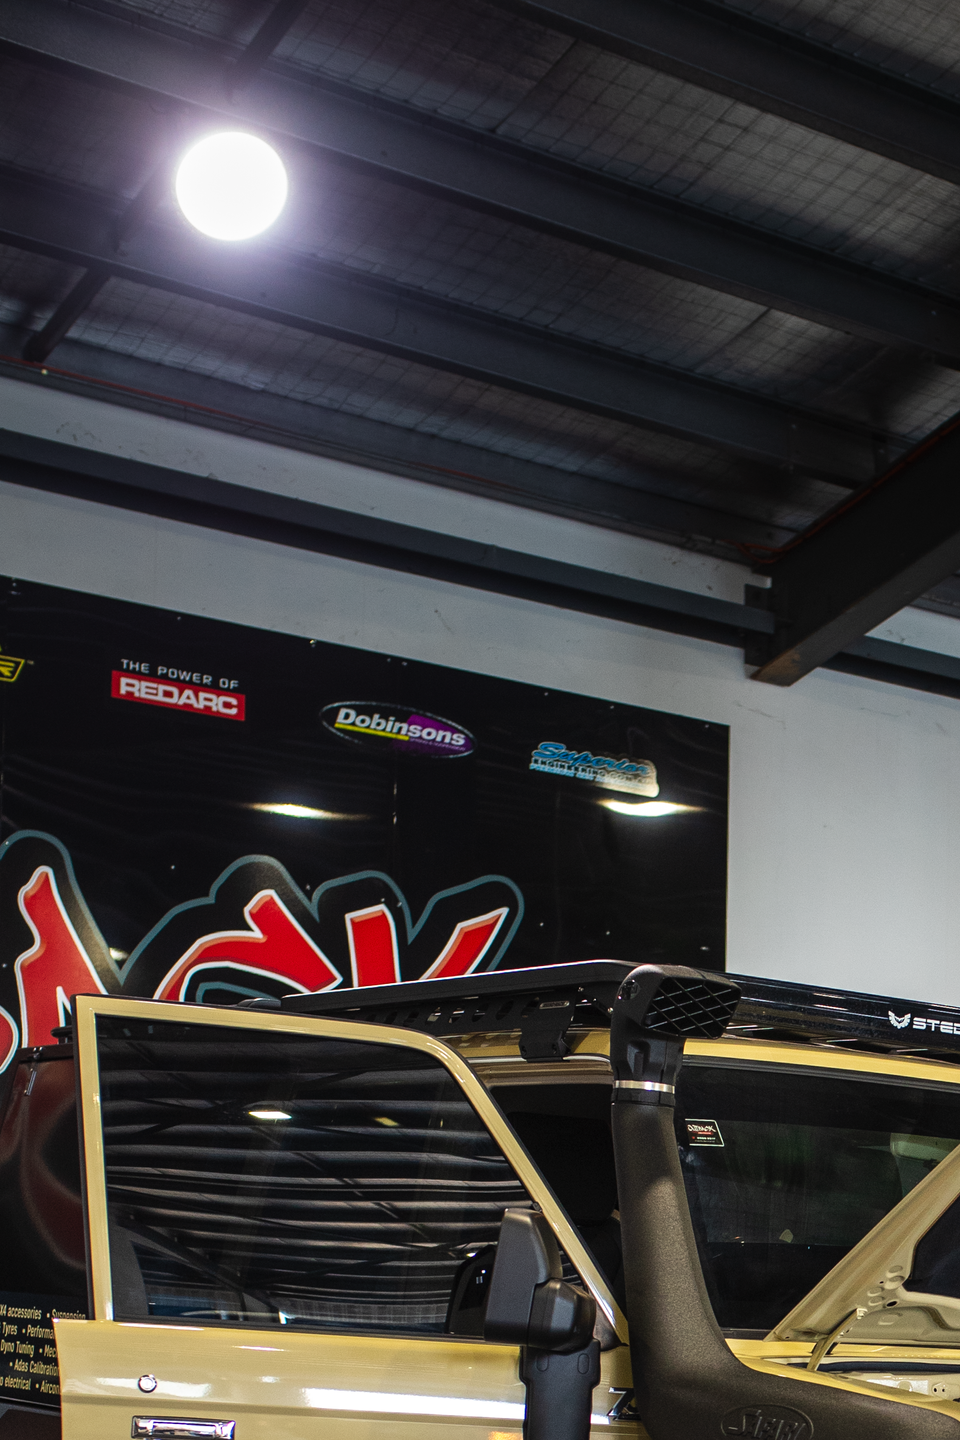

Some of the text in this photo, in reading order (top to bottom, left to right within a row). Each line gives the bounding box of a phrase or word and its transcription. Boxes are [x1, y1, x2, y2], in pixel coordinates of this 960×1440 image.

[120, 658, 239, 689] THE POWER OF
[119, 676, 238, 715] REDARC
[336, 707, 466, 746] Dobinsons
[532, 741, 651, 776] Superior
[7, 1306, 42, 1320] accessories
[2, 1322, 18, 1337] Tyres
[16, 1341, 35, 1357] Tuning
[4, 1375, 31, 1390] electrical
